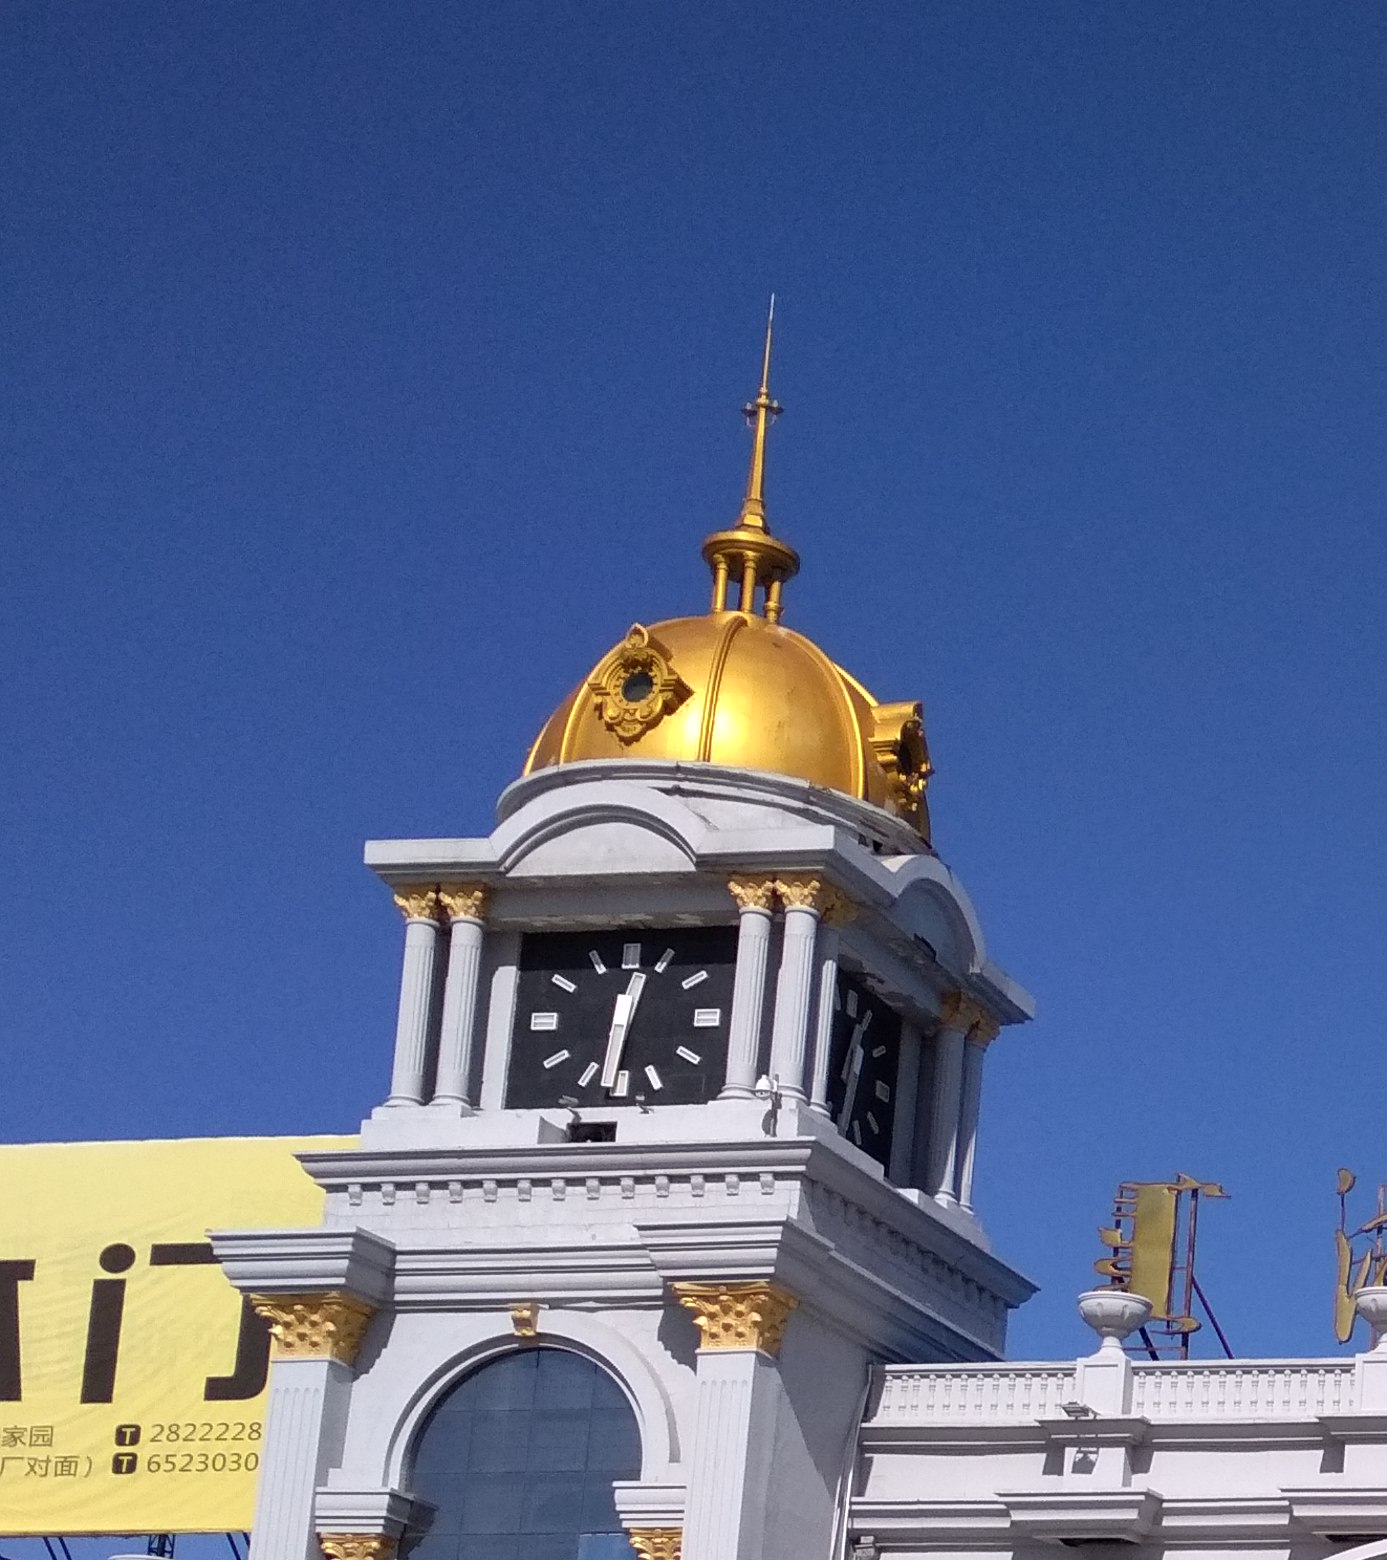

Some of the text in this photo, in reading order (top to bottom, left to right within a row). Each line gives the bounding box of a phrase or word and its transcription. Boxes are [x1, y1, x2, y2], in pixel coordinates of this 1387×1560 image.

[1, 1426, 54, 1448] 家园
[149, 1422, 263, 1443] 2822228
[146, 1452, 259, 1473] 6523030
